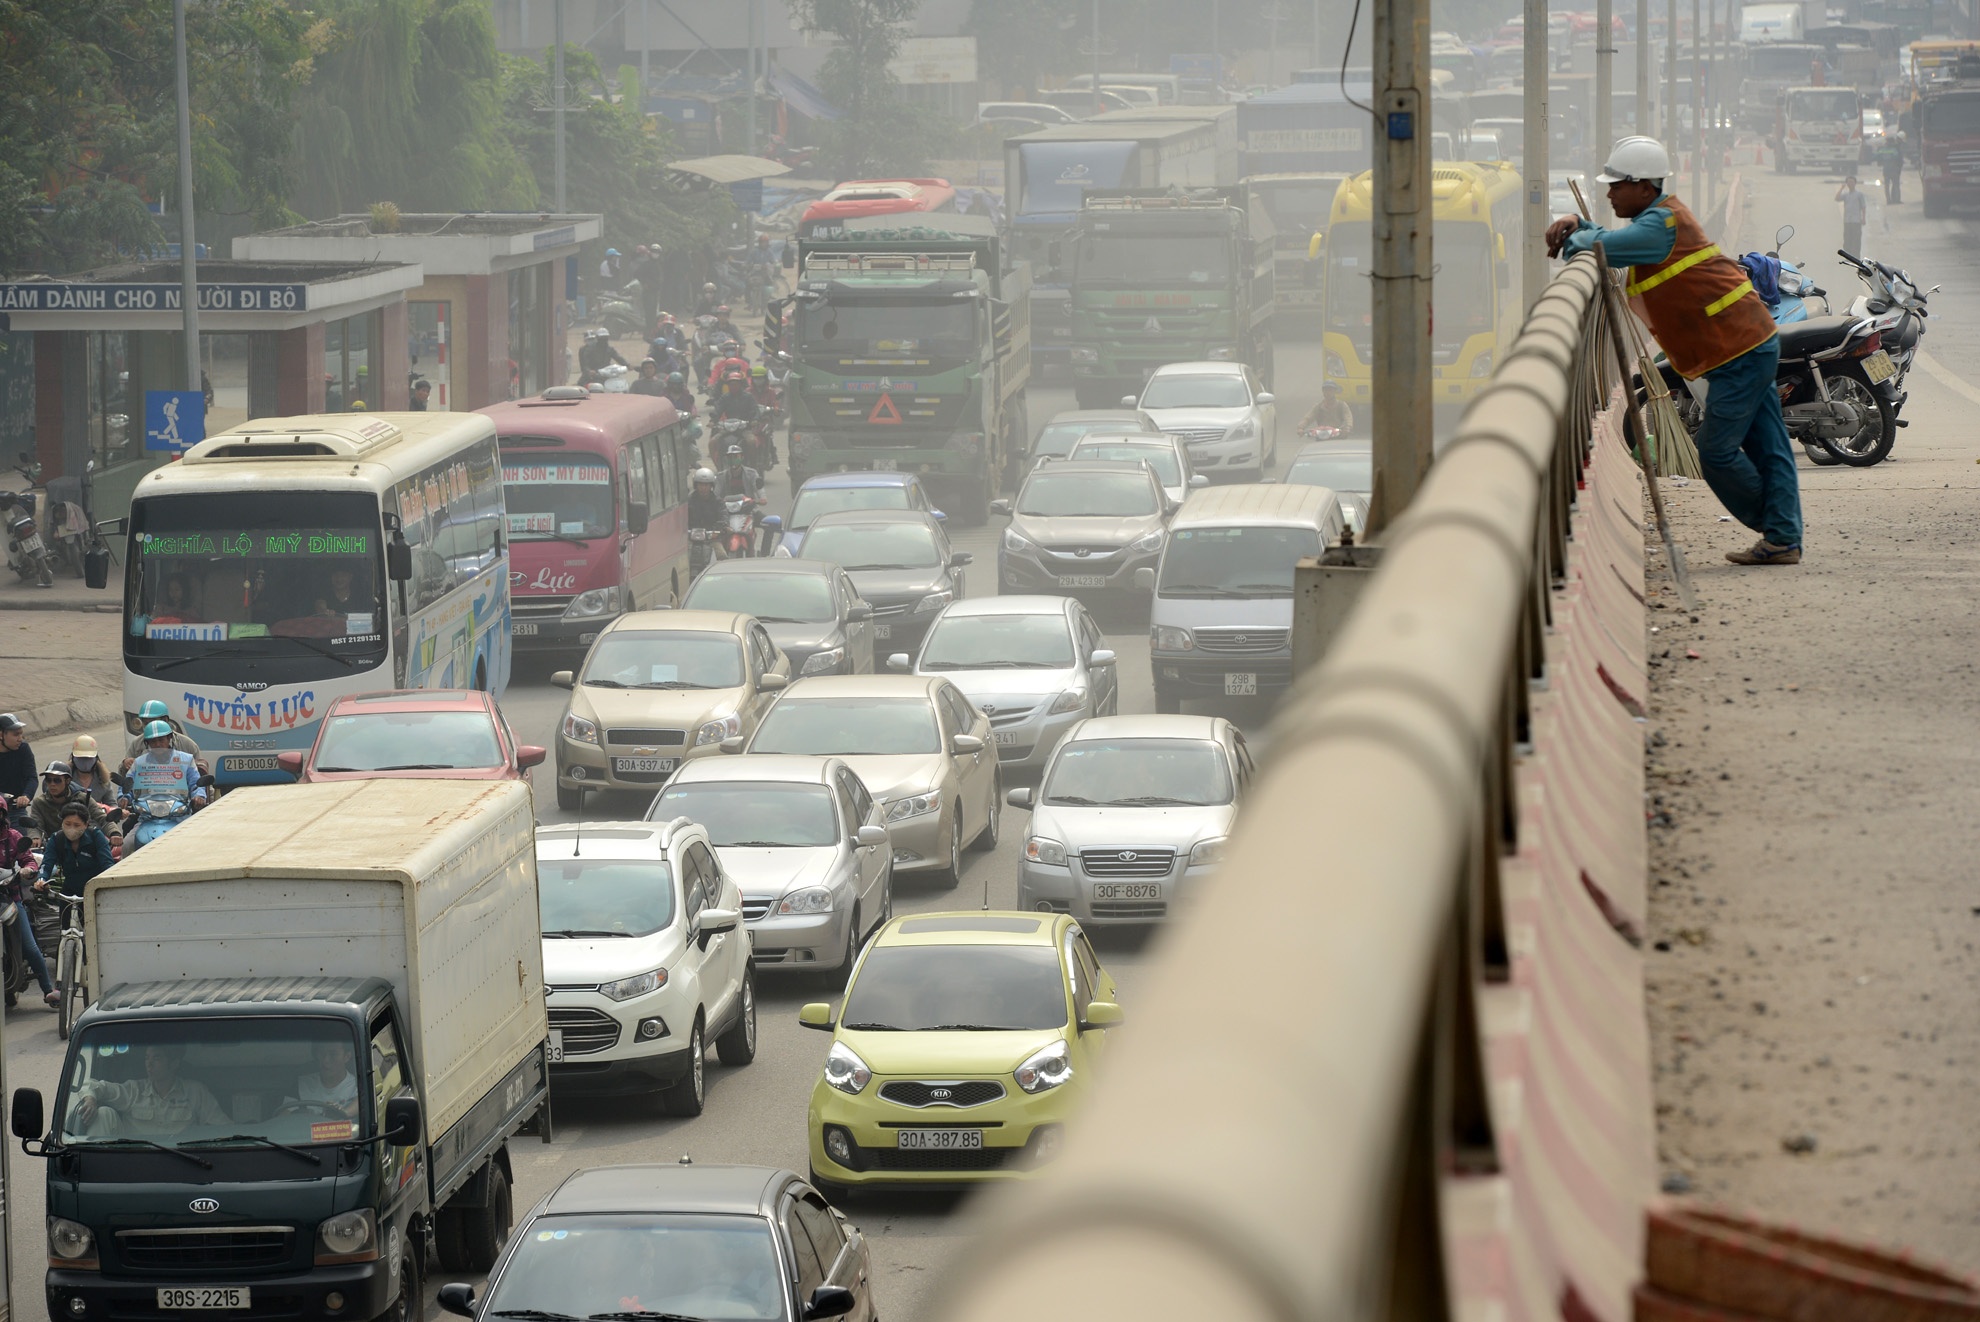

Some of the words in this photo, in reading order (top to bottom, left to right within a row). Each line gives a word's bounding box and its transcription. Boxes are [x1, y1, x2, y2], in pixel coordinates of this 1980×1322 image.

[0, 285, 38, 308] ẦM
[47, 285, 105, 308] DÀNH
[114, 290, 156, 308] CHO
[165, 286, 232, 308] NƯỜI
[240, 290, 261, 308] ĐI
[269, 286, 296, 310] BỘ
[143, 534, 216, 555] NGHĨA
[222, 532, 253, 556] LỘ
[265, 532, 303, 553] MỸ
[308, 533, 367, 553] ĐÌNH
[530, 567, 575, 593] Lực
[236, 682, 267, 690] SAMCO
[1232, 674, 1249, 684] 29B
[183, 692, 261, 731] TUYẾN
[268, 691, 315, 729] LỰC
[229, 739, 277, 750] ISUZU
[618, 759, 672, 771] 30A-937.47
[1098, 885, 1157, 898] 30F-8876
[900, 1132, 980, 1148] 30A-387.85
[194, 1201, 215, 1210] KIA
[163, 1290, 240, 1308] 30S-2215
